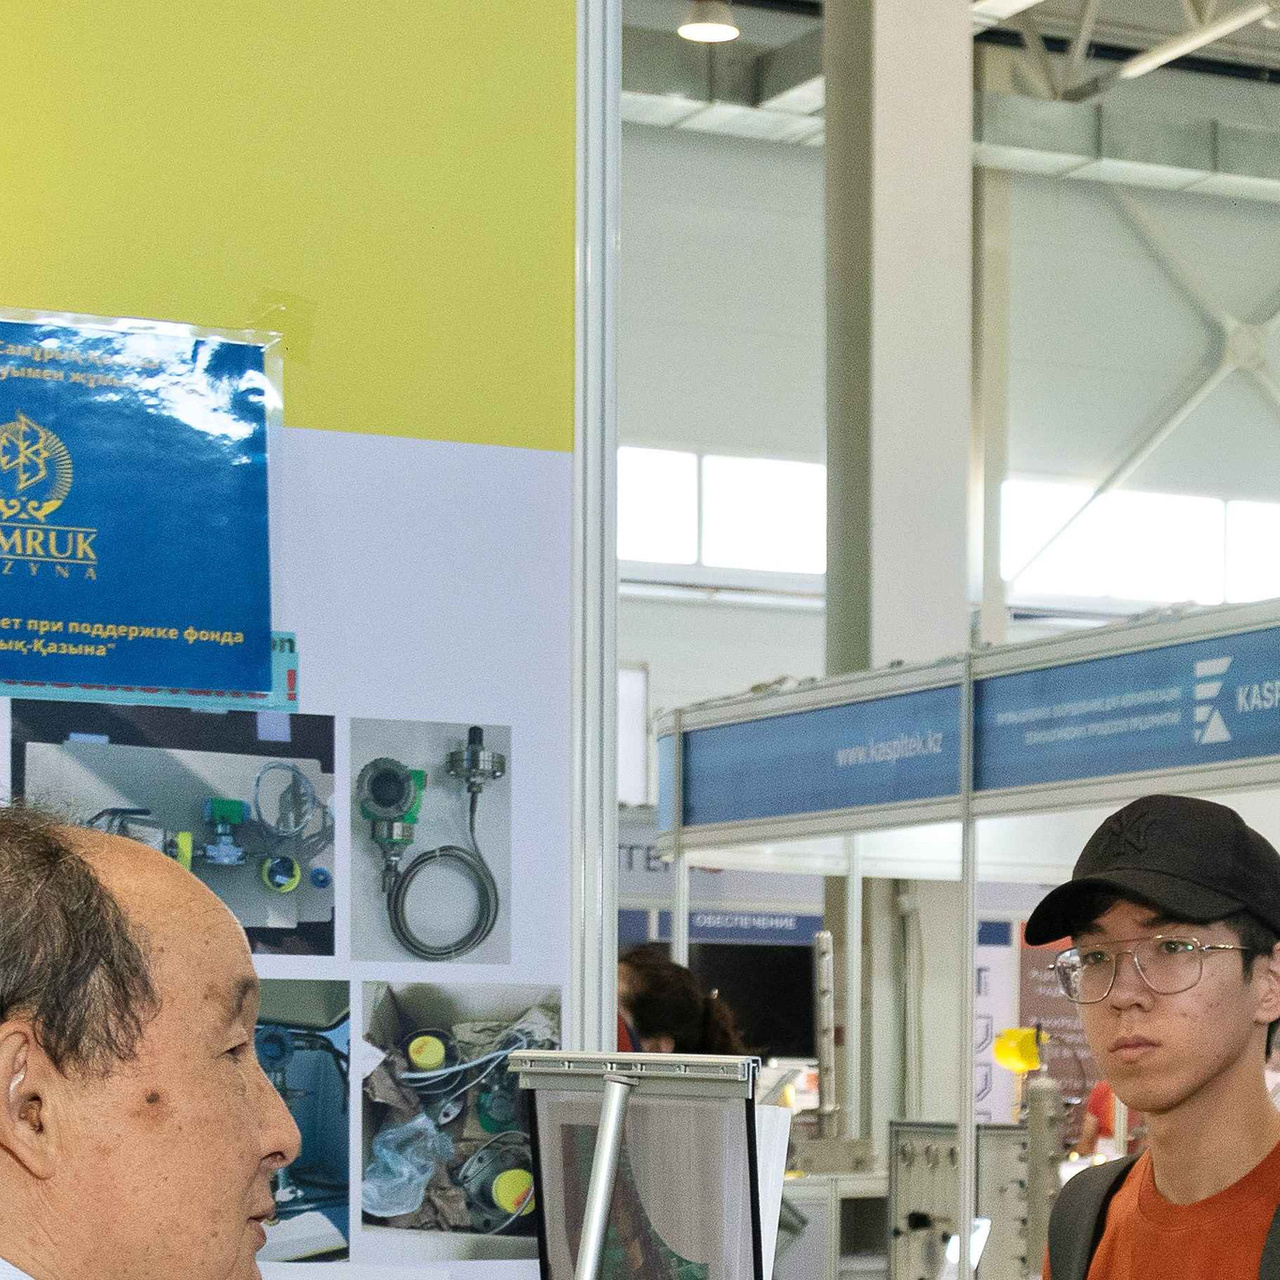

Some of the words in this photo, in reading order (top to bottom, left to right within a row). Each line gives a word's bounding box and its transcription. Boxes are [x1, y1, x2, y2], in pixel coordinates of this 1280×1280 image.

[27, 619, 63, 635] при
[68, 622, 178, 641] поддержке
[183, 626, 244, 646] фонда
